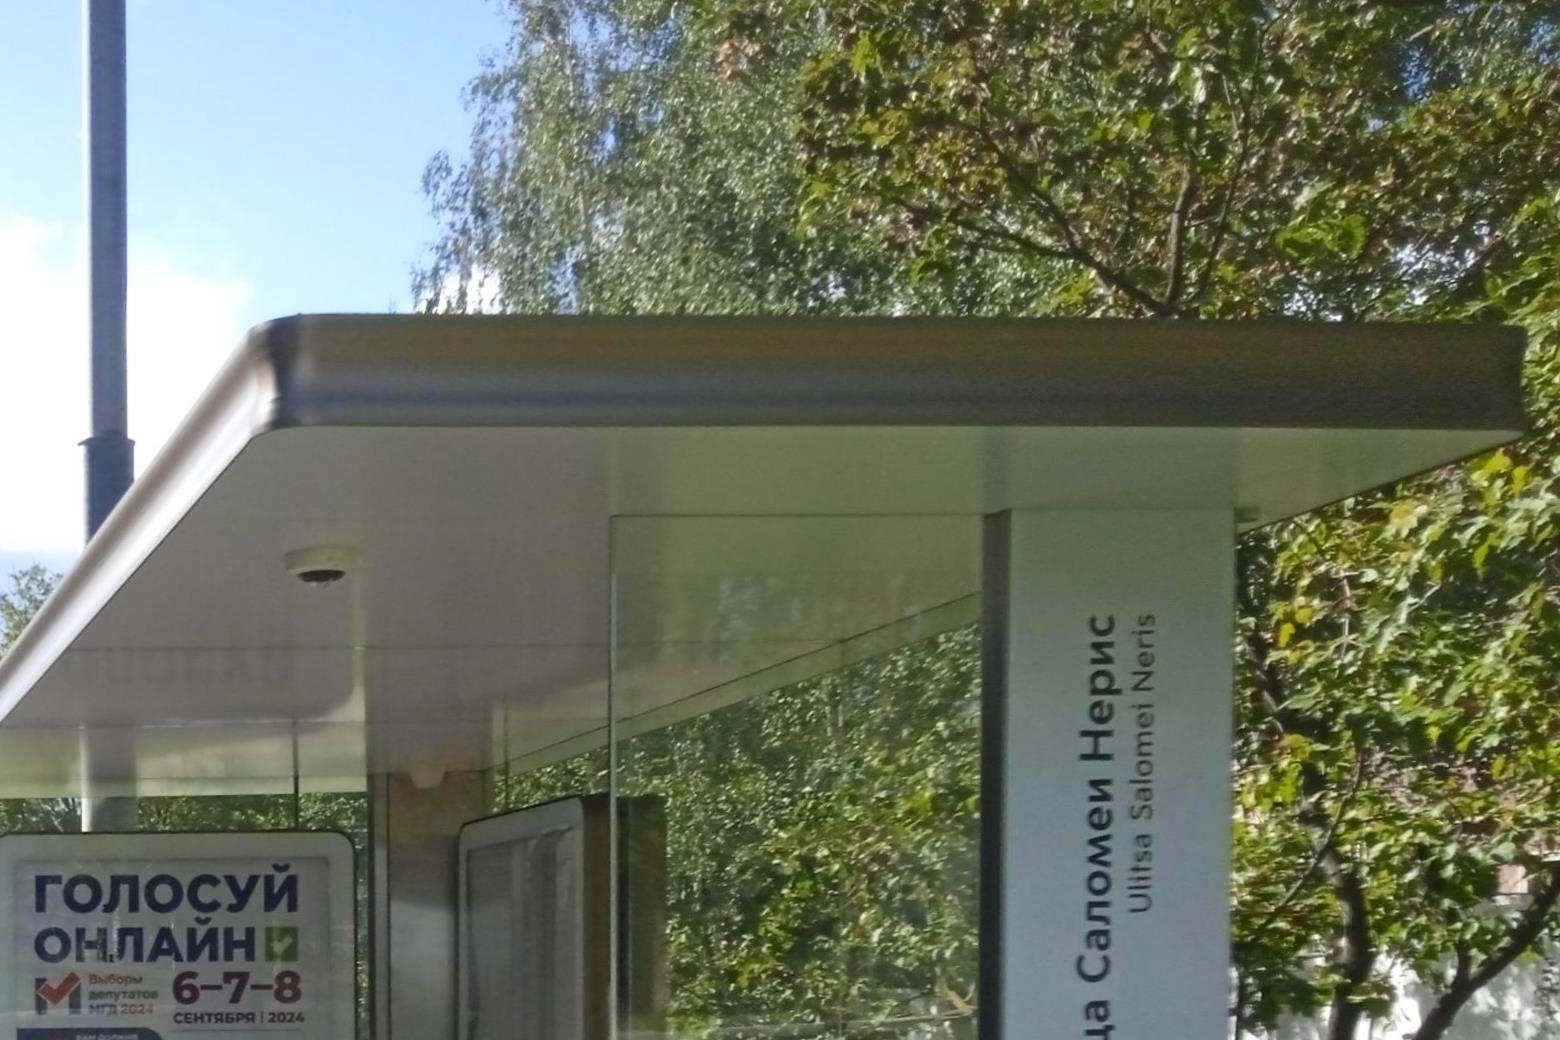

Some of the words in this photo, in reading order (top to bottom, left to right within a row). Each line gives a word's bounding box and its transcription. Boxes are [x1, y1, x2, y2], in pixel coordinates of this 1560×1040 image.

[1131, 614, 1156, 691] Neris
[1078, 615, 1124, 761] Нерис
[1128, 704, 1155, 820] Salomei
[34, 863, 298, 914] ГОЛОСУЙ
[1075, 779, 1114, 983] Саломеи
[1128, 834, 1153, 913] Ulitsa
[34, 916, 256, 963] ОНЛАЙН
[88, 974, 143, 987] Выборы
[88, 990, 159, 1002] депутатов
[120, 1003, 154, 1015] 2024
[173, 1012, 256, 1024] СЕНТЯБРЯ
[268, 1011, 305, 1023] 2024
